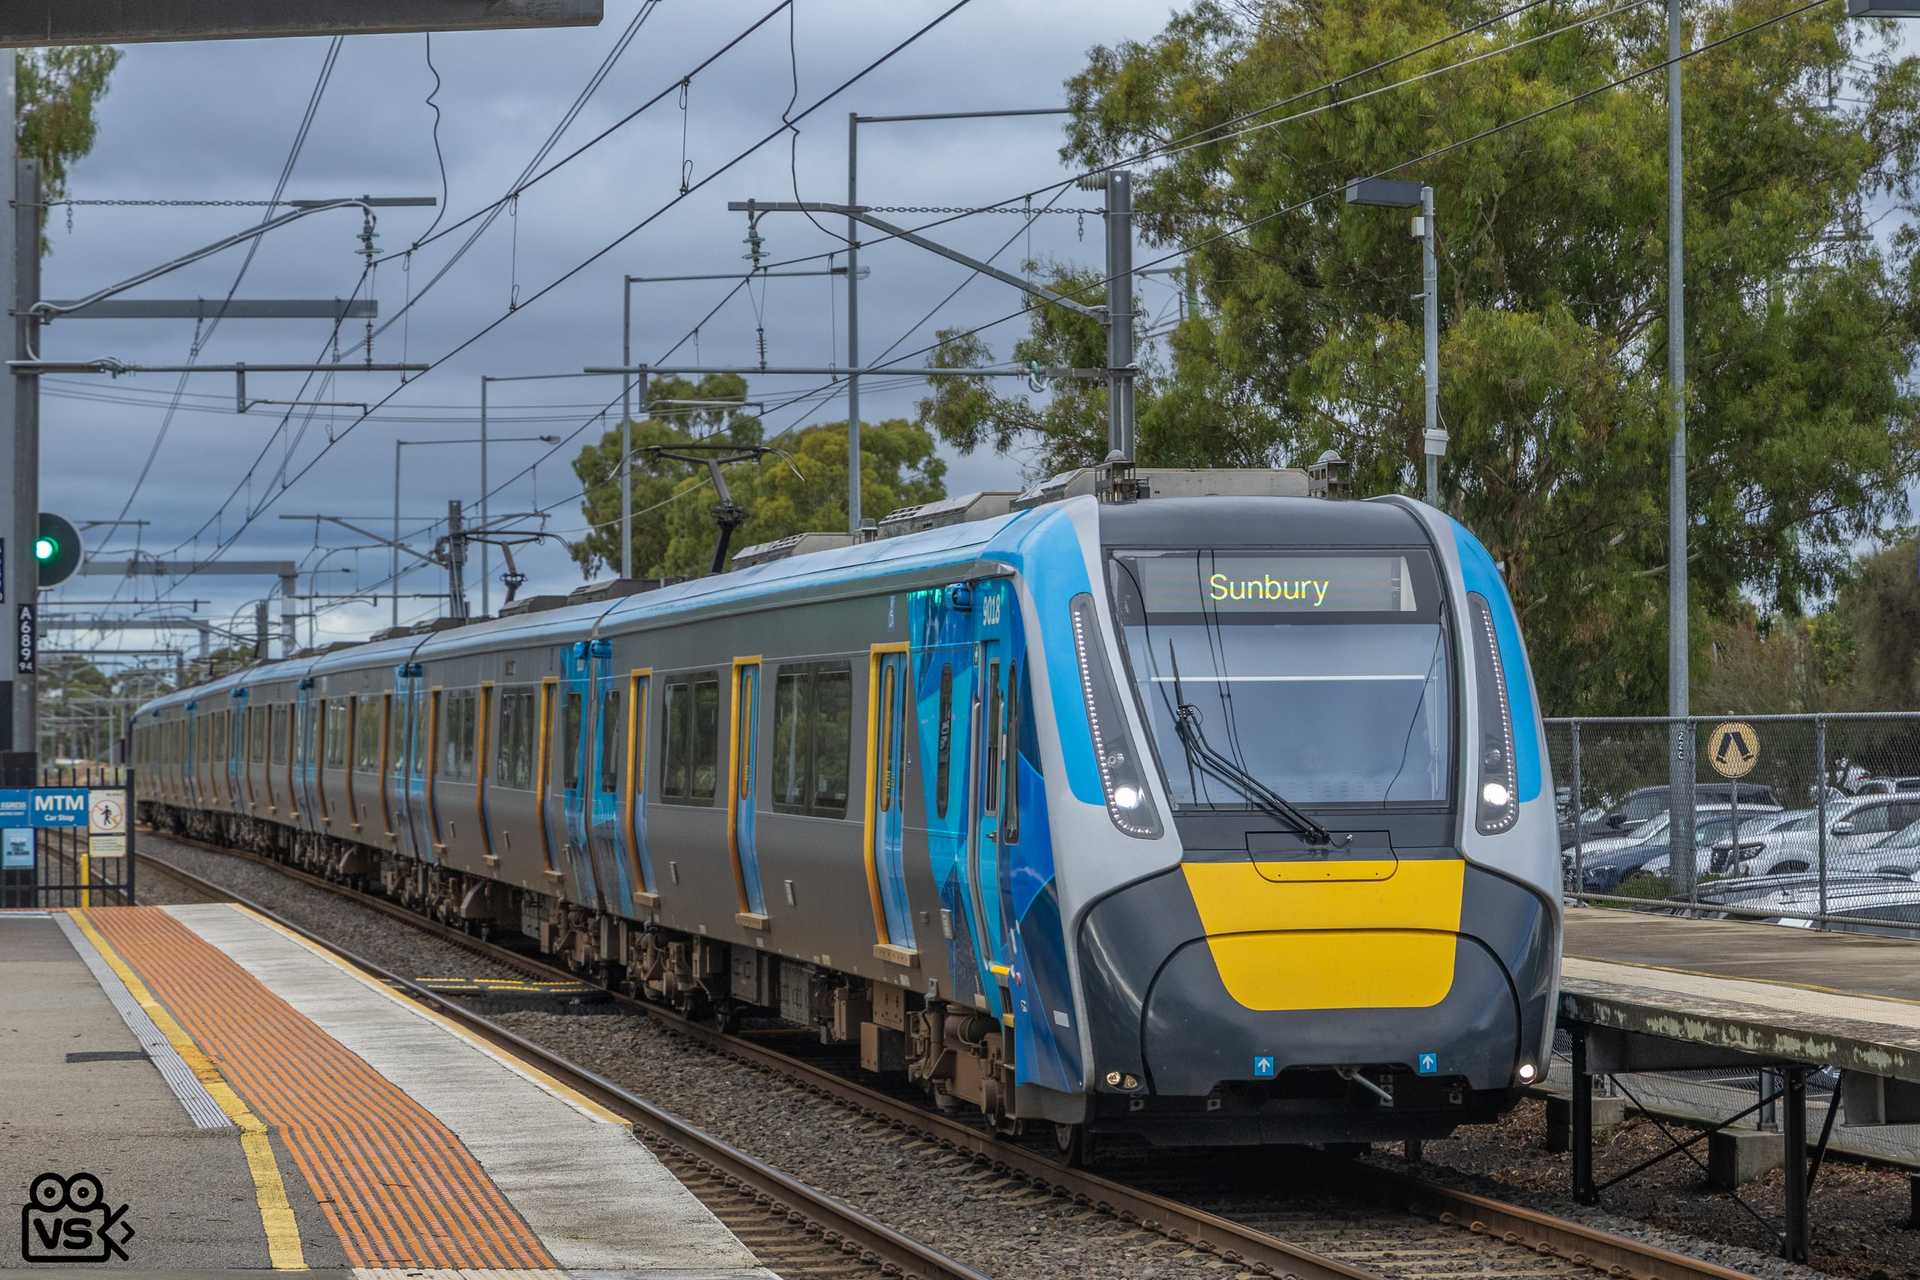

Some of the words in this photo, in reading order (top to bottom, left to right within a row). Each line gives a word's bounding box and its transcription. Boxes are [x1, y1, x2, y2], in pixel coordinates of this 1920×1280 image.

[1210, 573, 1329, 606] Sunbury
[983, 594, 1000, 625] 9018
[20, 606, 32, 661] A689
[35, 795, 84, 811] MTM
